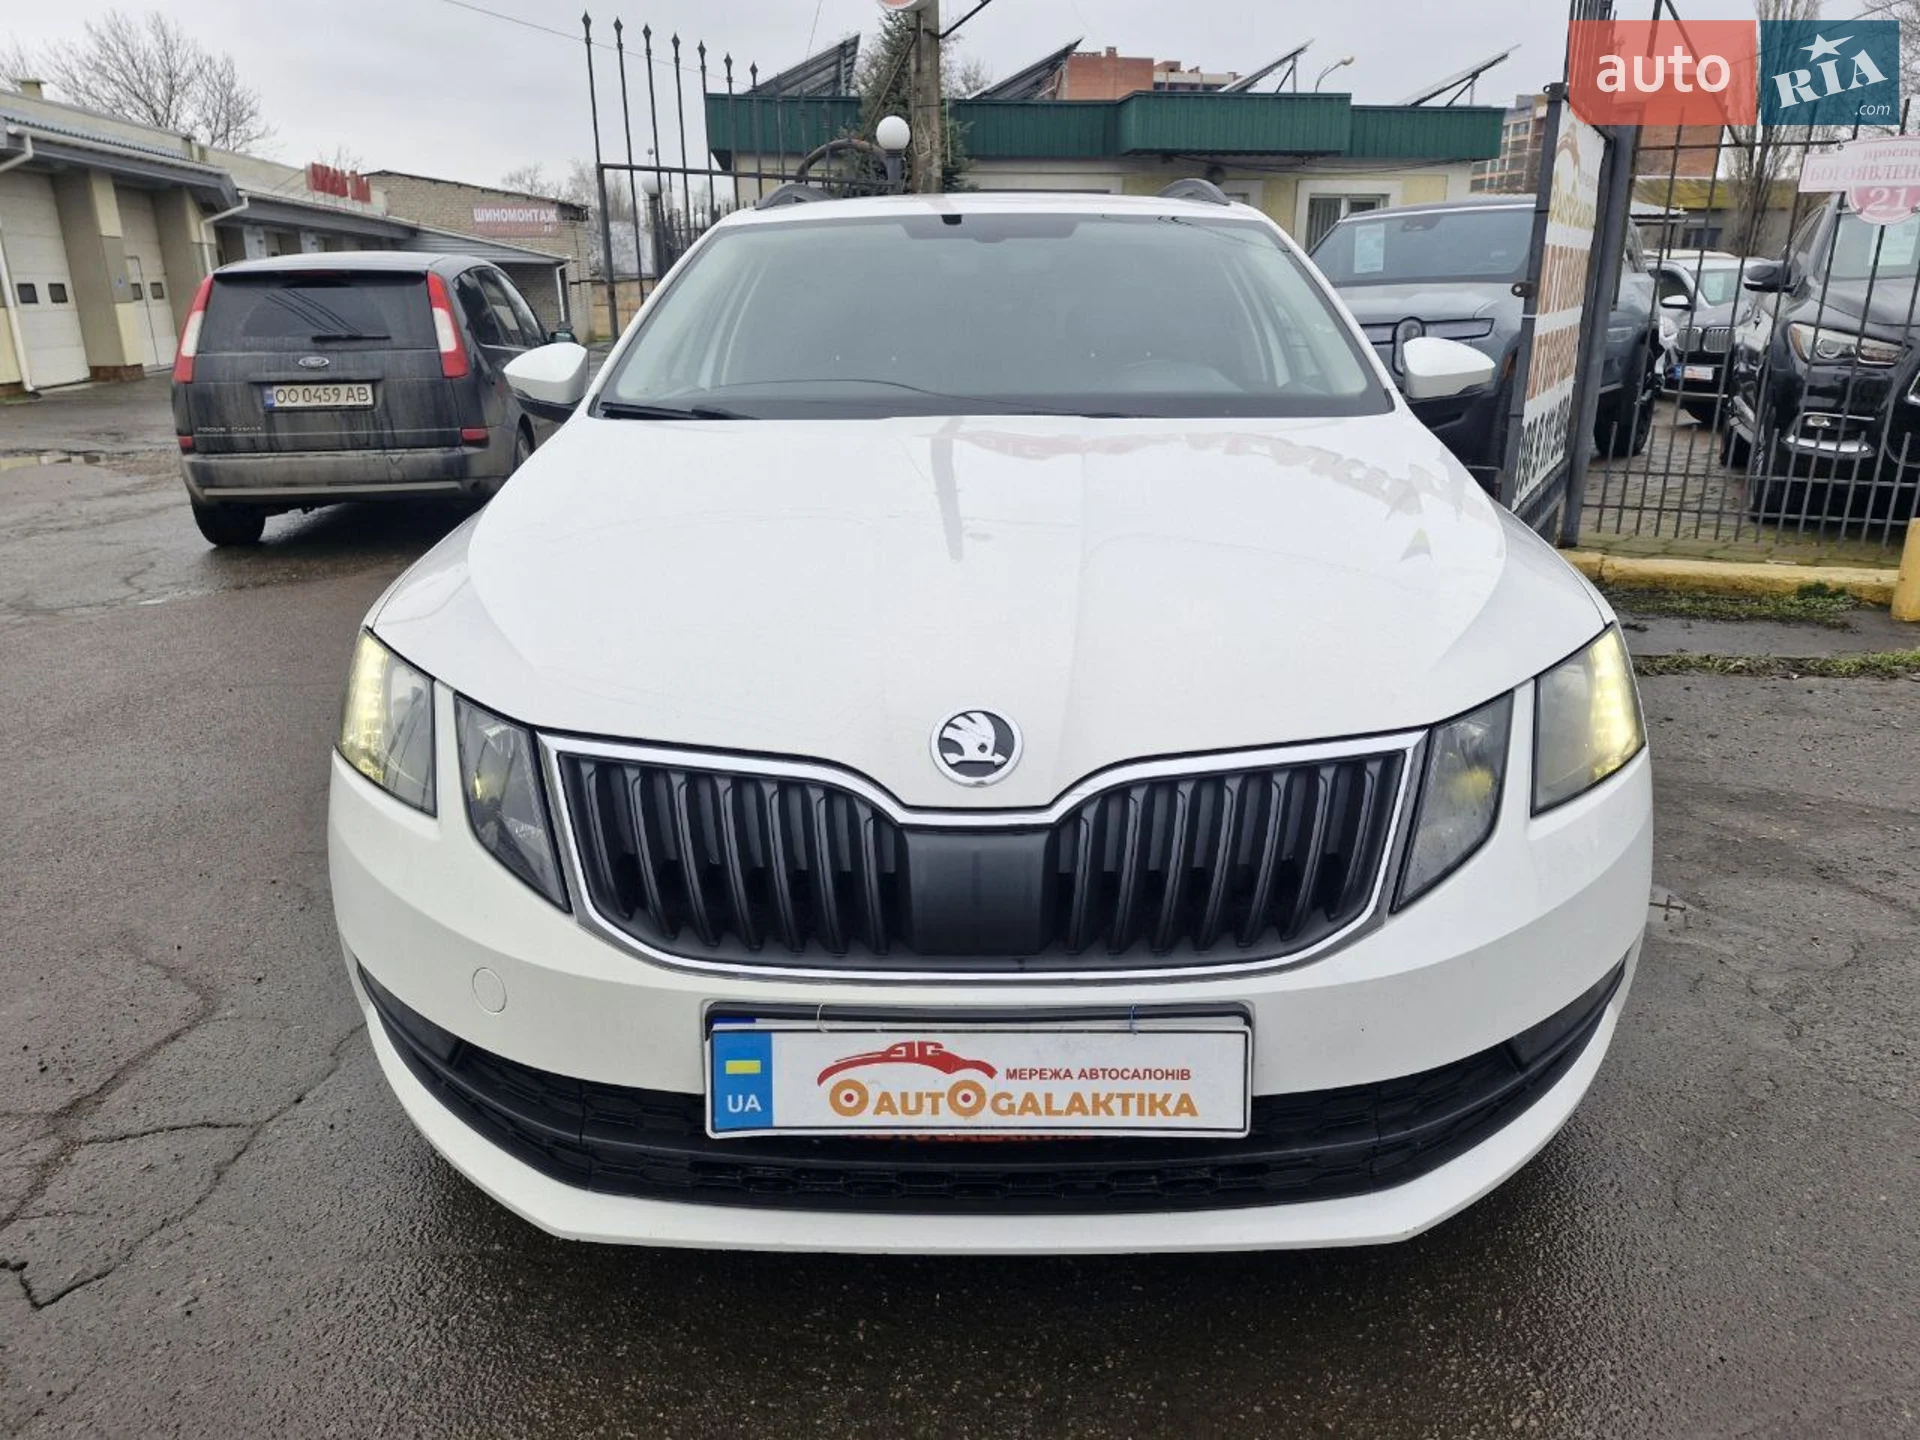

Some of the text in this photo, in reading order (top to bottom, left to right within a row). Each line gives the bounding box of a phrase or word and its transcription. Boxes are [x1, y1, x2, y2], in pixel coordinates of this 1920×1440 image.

[1866, 187, 1909, 212] 21
[473, 207, 558, 222] ШИНОМОНТАЖ
[303, 387, 341, 403] 0459
[1006, 1068, 1192, 1081] МЕРЕЖА АВТОСАЛОНІВ
[726, 1094, 762, 1113] UA
